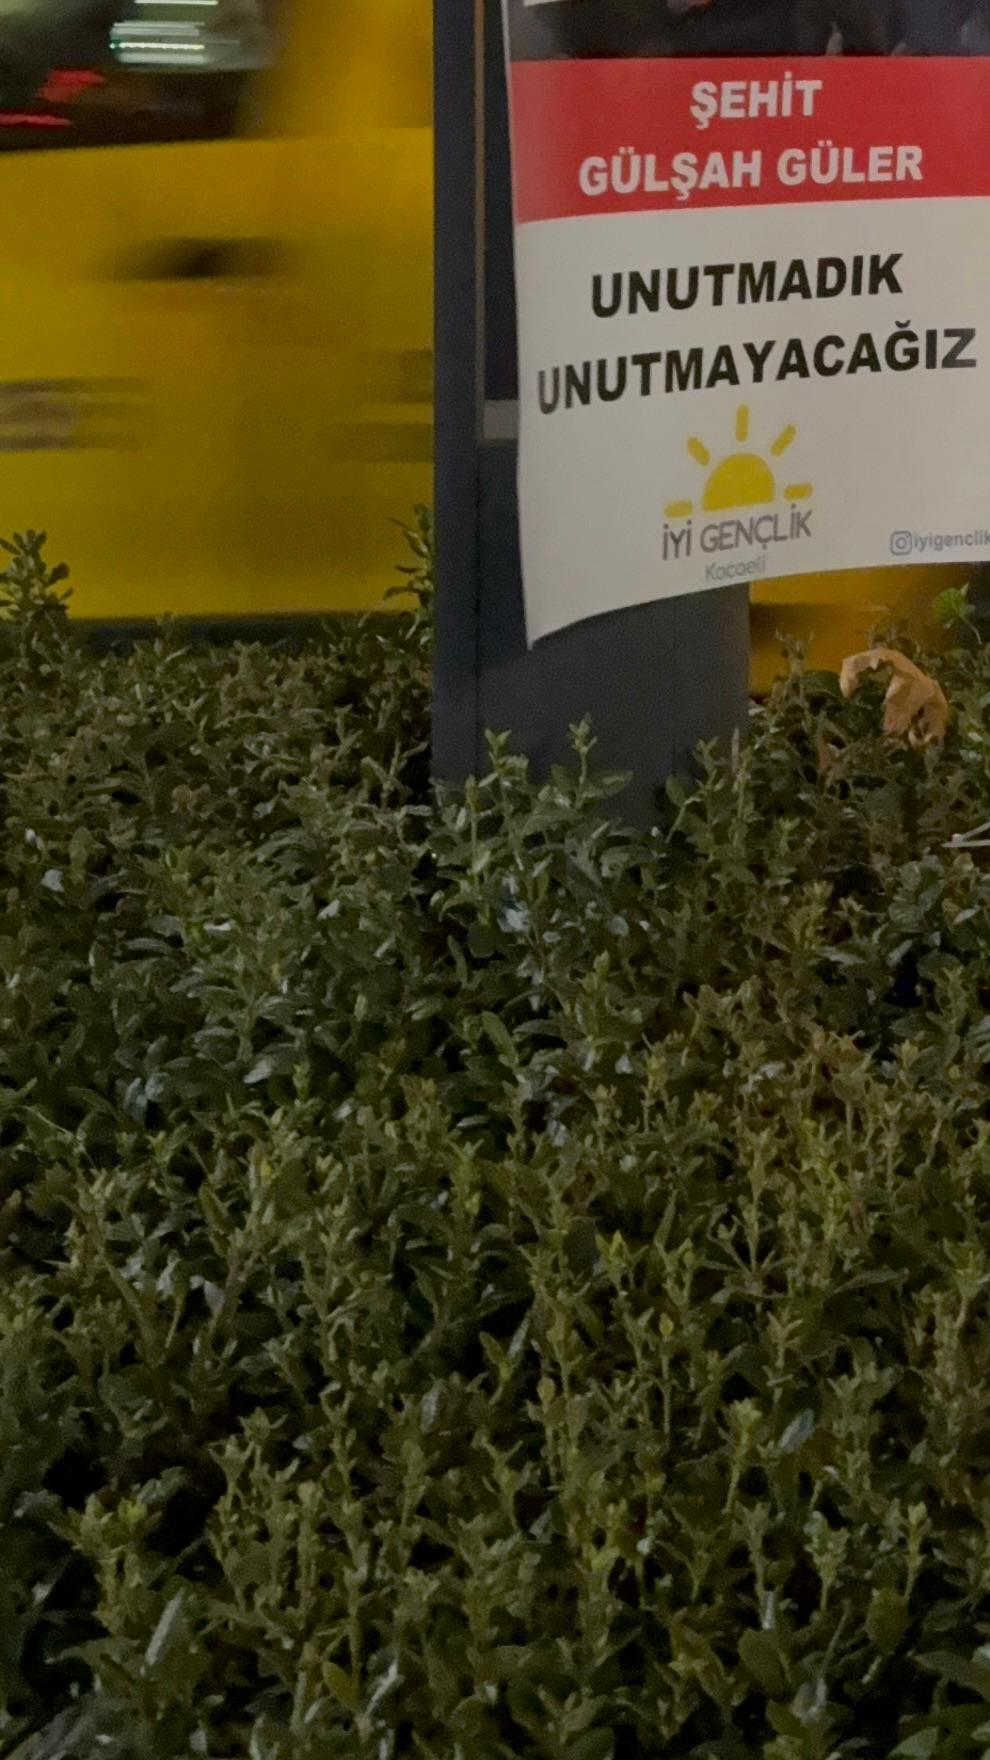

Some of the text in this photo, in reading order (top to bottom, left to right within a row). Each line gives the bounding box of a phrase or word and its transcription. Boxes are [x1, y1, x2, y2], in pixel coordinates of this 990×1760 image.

[690, 71, 823, 129] ŞEHİT
[578, 140, 924, 200] GÜLŞAH GÜLER
[591, 253, 904, 318] UNUTMADIK
[537, 320, 977, 414] UNUTMAYACAĞIZ
[662, 503, 813, 560] İYİ GENÇLİK
[704, 556, 767, 582] Kocaeli
